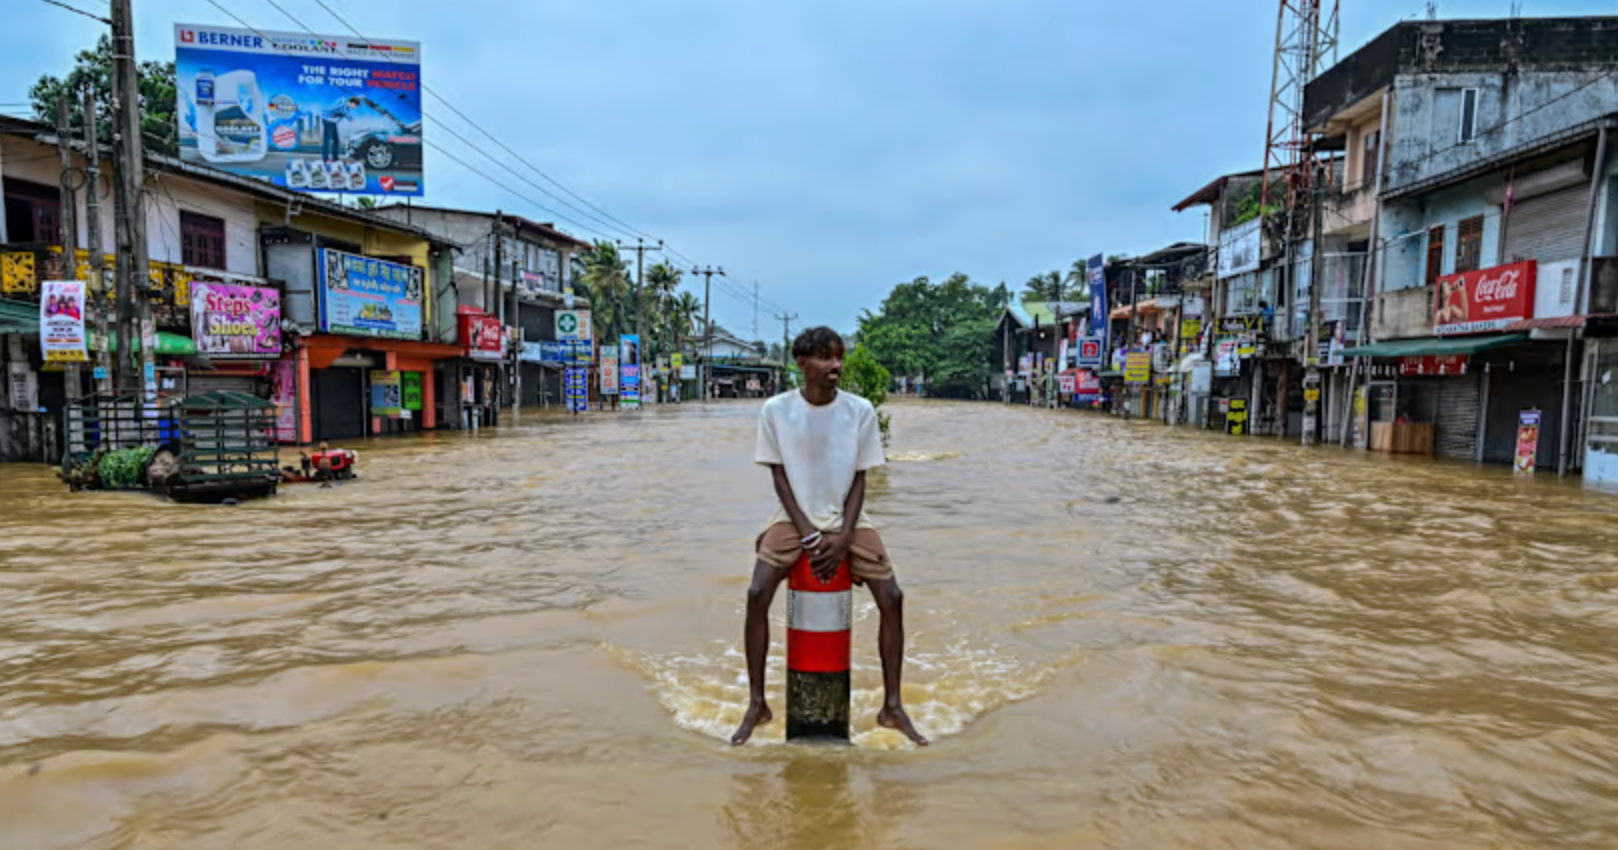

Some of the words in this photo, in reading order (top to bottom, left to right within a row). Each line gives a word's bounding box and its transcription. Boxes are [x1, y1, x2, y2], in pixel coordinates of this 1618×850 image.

[198, 32, 263, 49] BERNER
[301, 64, 326, 74] THE
[329, 66, 369, 78] RIGHT
[298, 74, 324, 84] FOR
[328, 76, 363, 87] YOUR
[365, 79, 416, 90] VEHICLE
[1474, 269, 1519, 302] Coca-Cola
[205, 290, 251, 317] Steps
[209, 314, 257, 336] Shoes
